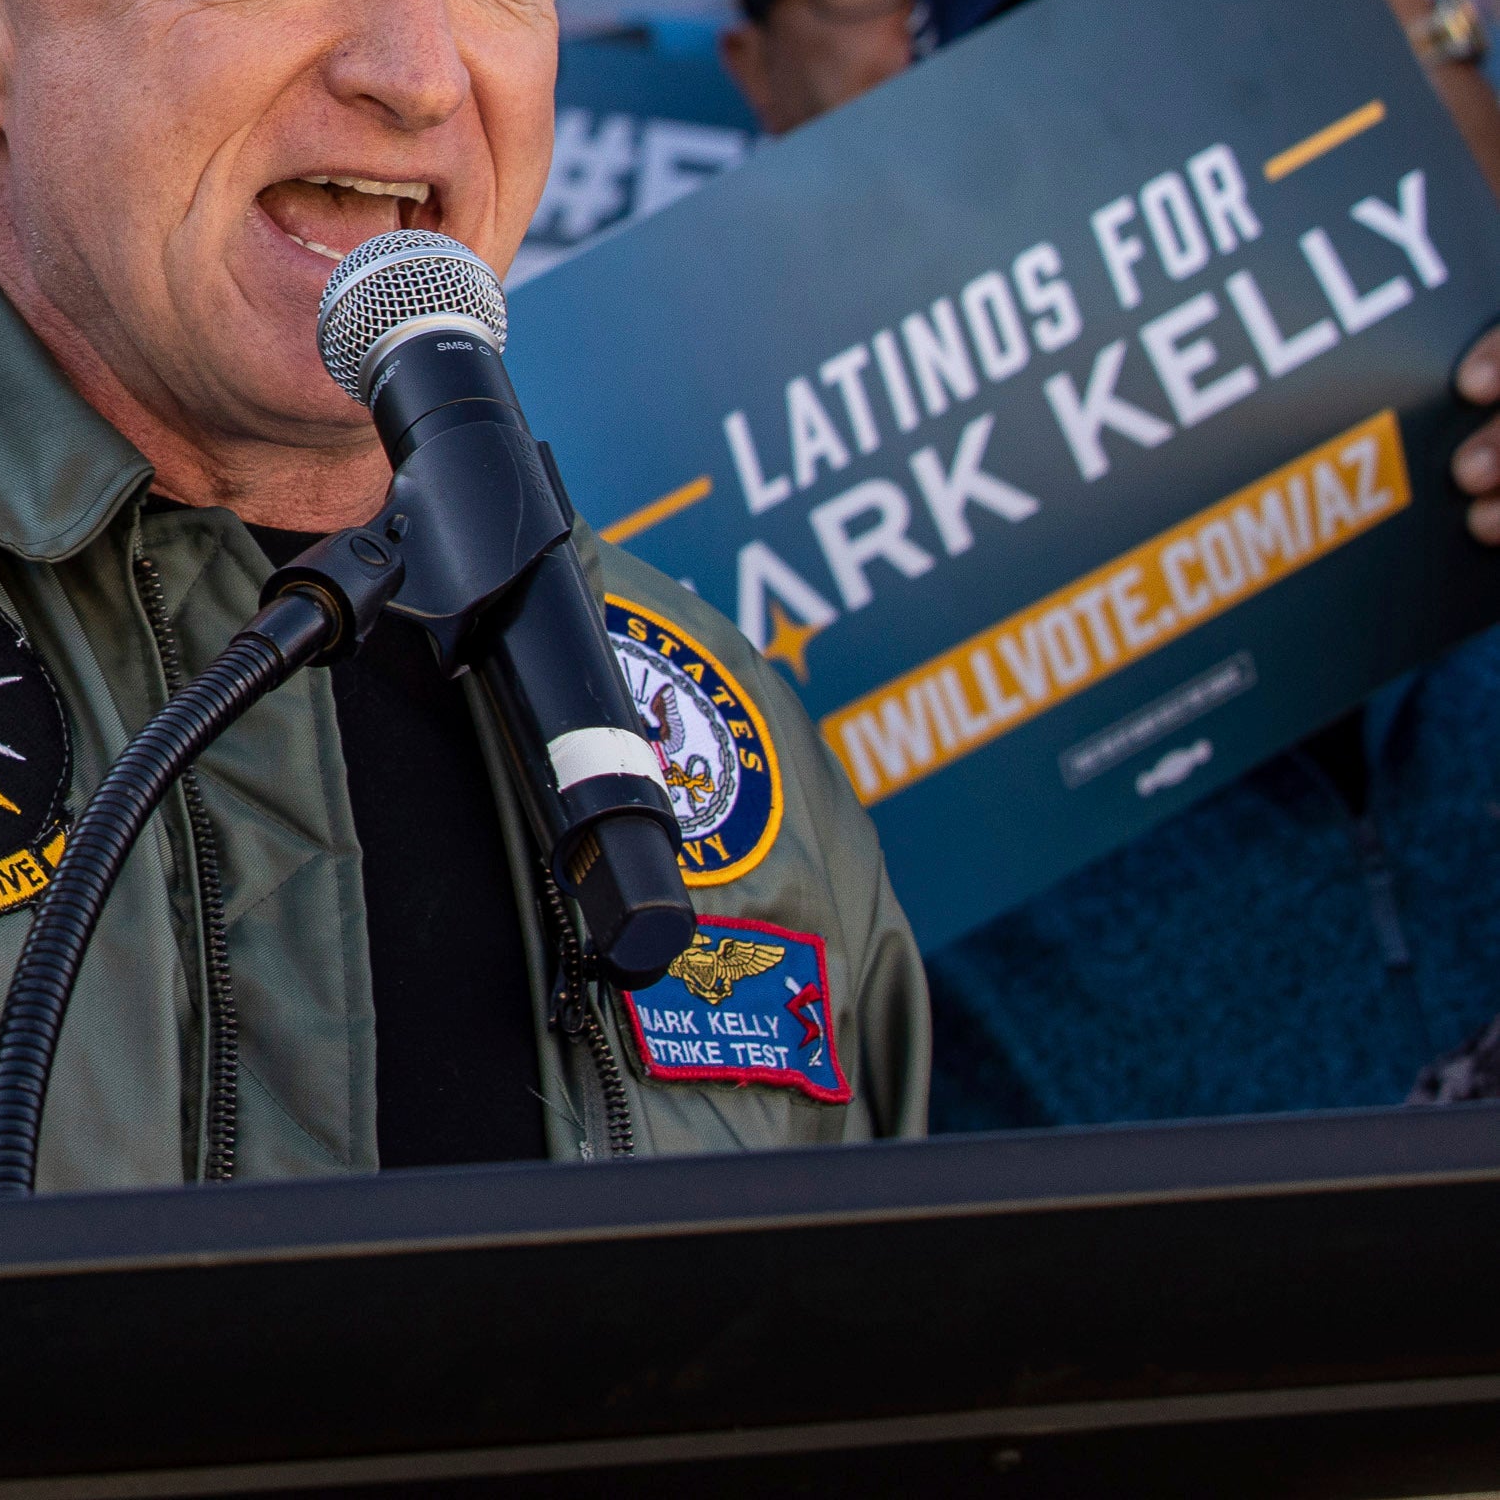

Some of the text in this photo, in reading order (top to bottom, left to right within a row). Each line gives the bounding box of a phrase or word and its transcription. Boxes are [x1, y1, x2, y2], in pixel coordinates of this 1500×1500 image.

[436, 341, 474, 352] SM58
[723, 142, 1260, 516] LATINOS FOR
[684, 170, 1449, 654] ARK KELLY
[839, 437, 1395, 793] IWILLVOTE.COM/AZ
[627, 617, 764, 773] STATES
[637, 1005, 779, 1039] MARK KELLY
[646, 1035, 789, 1070] STRIKE TEST
